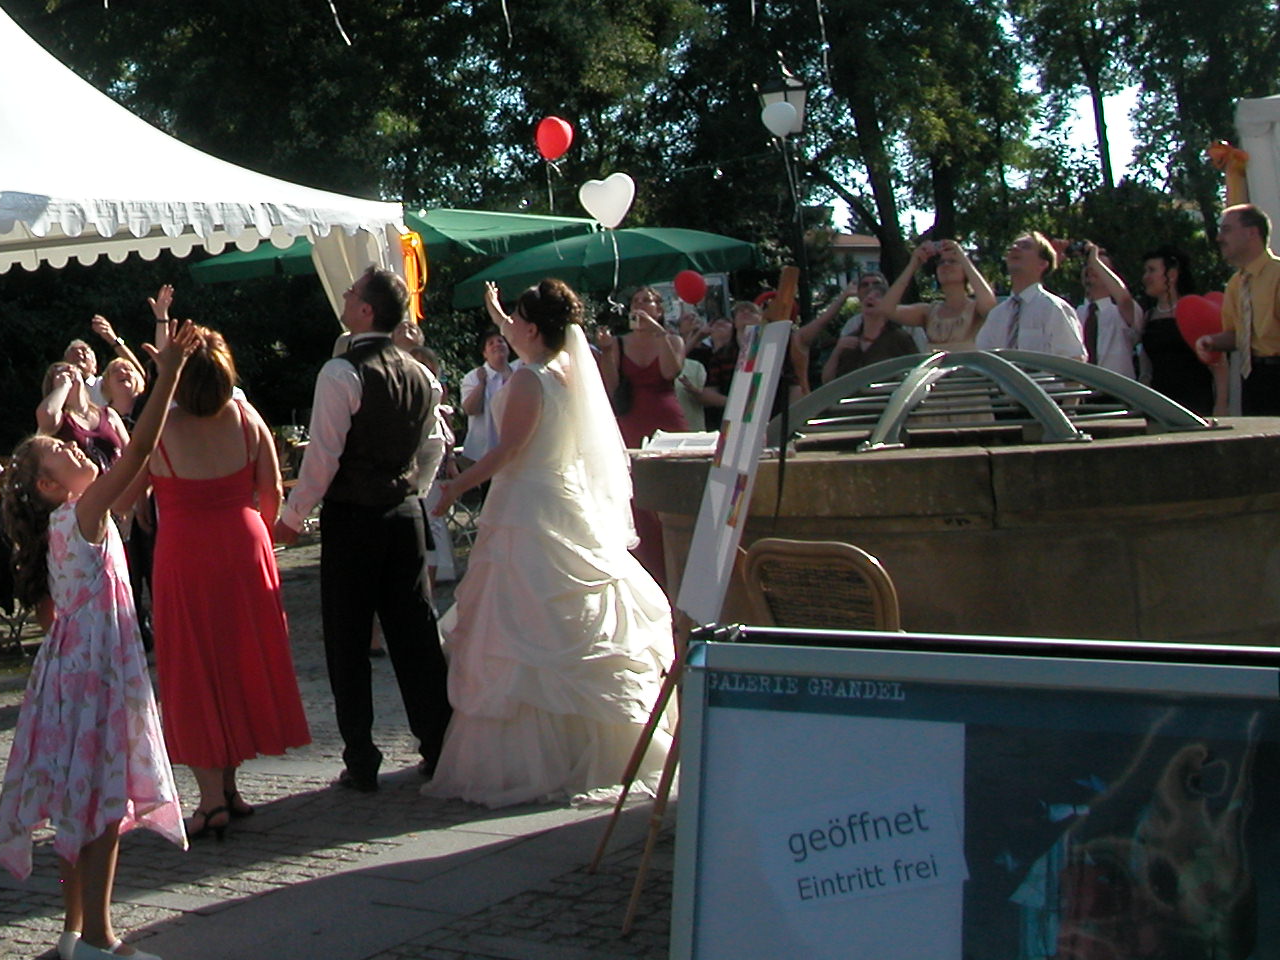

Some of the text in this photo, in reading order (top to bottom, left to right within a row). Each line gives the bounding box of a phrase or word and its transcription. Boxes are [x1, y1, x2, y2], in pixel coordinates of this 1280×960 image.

[708, 673, 906, 701] GALERIE GRANDEL
[788, 804, 930, 863] geöffnet
[797, 854, 939, 901] Eintritt frei
